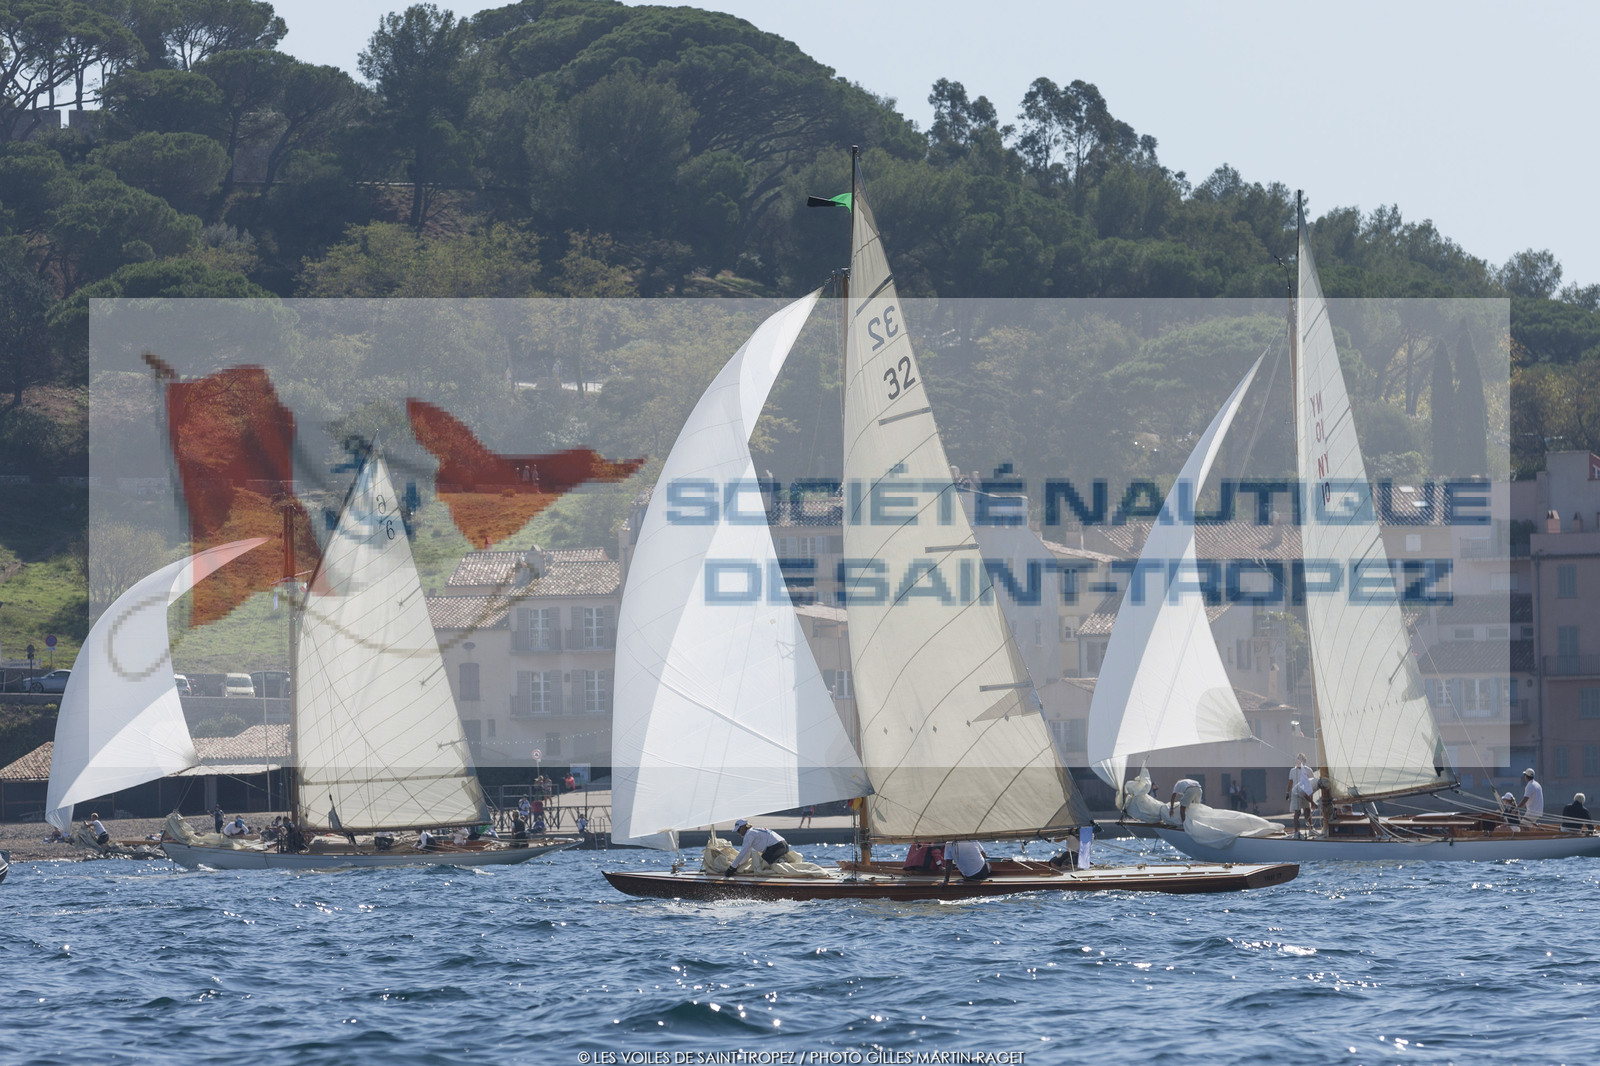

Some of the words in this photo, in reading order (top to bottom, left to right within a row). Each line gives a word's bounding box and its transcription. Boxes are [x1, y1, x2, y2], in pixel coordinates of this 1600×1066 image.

[883, 355, 916, 401] 32
[1317, 450, 1330, 480] NY
[385, 519, 396, 541] 6
